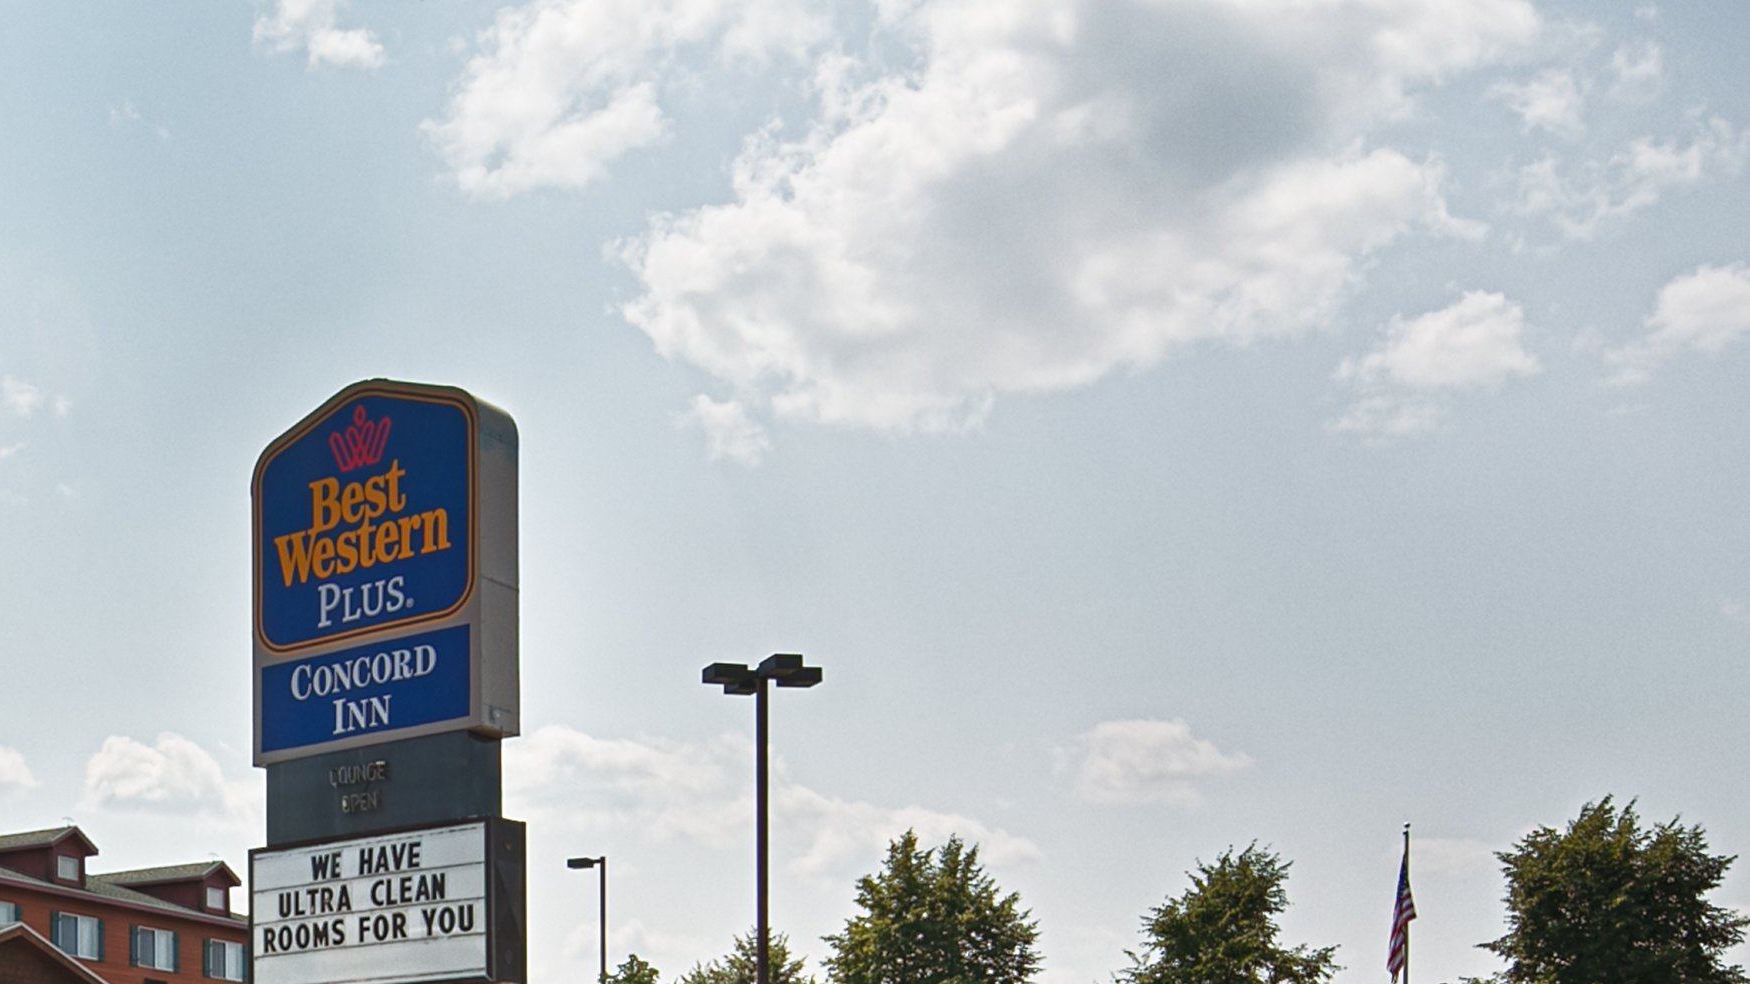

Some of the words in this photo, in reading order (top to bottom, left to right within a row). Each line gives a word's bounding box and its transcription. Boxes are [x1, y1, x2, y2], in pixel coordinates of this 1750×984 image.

[309, 459, 406, 532] Best
[274, 507, 451, 588] Western
[290, 644, 438, 701] CONCORD
[332, 694, 392, 735] INN
[329, 761, 386, 788] LOUNGE
[342, 791, 378, 813] OPEN
[311, 852, 342, 881] WE
[358, 841, 421, 875] HAVE
[278, 884, 351, 918] ULTRA
[370, 872, 446, 906] CLEAN
[263, 919, 345, 954] ROOMS
[358, 912, 407, 943] FOR
[422, 903, 474, 936] YOU
